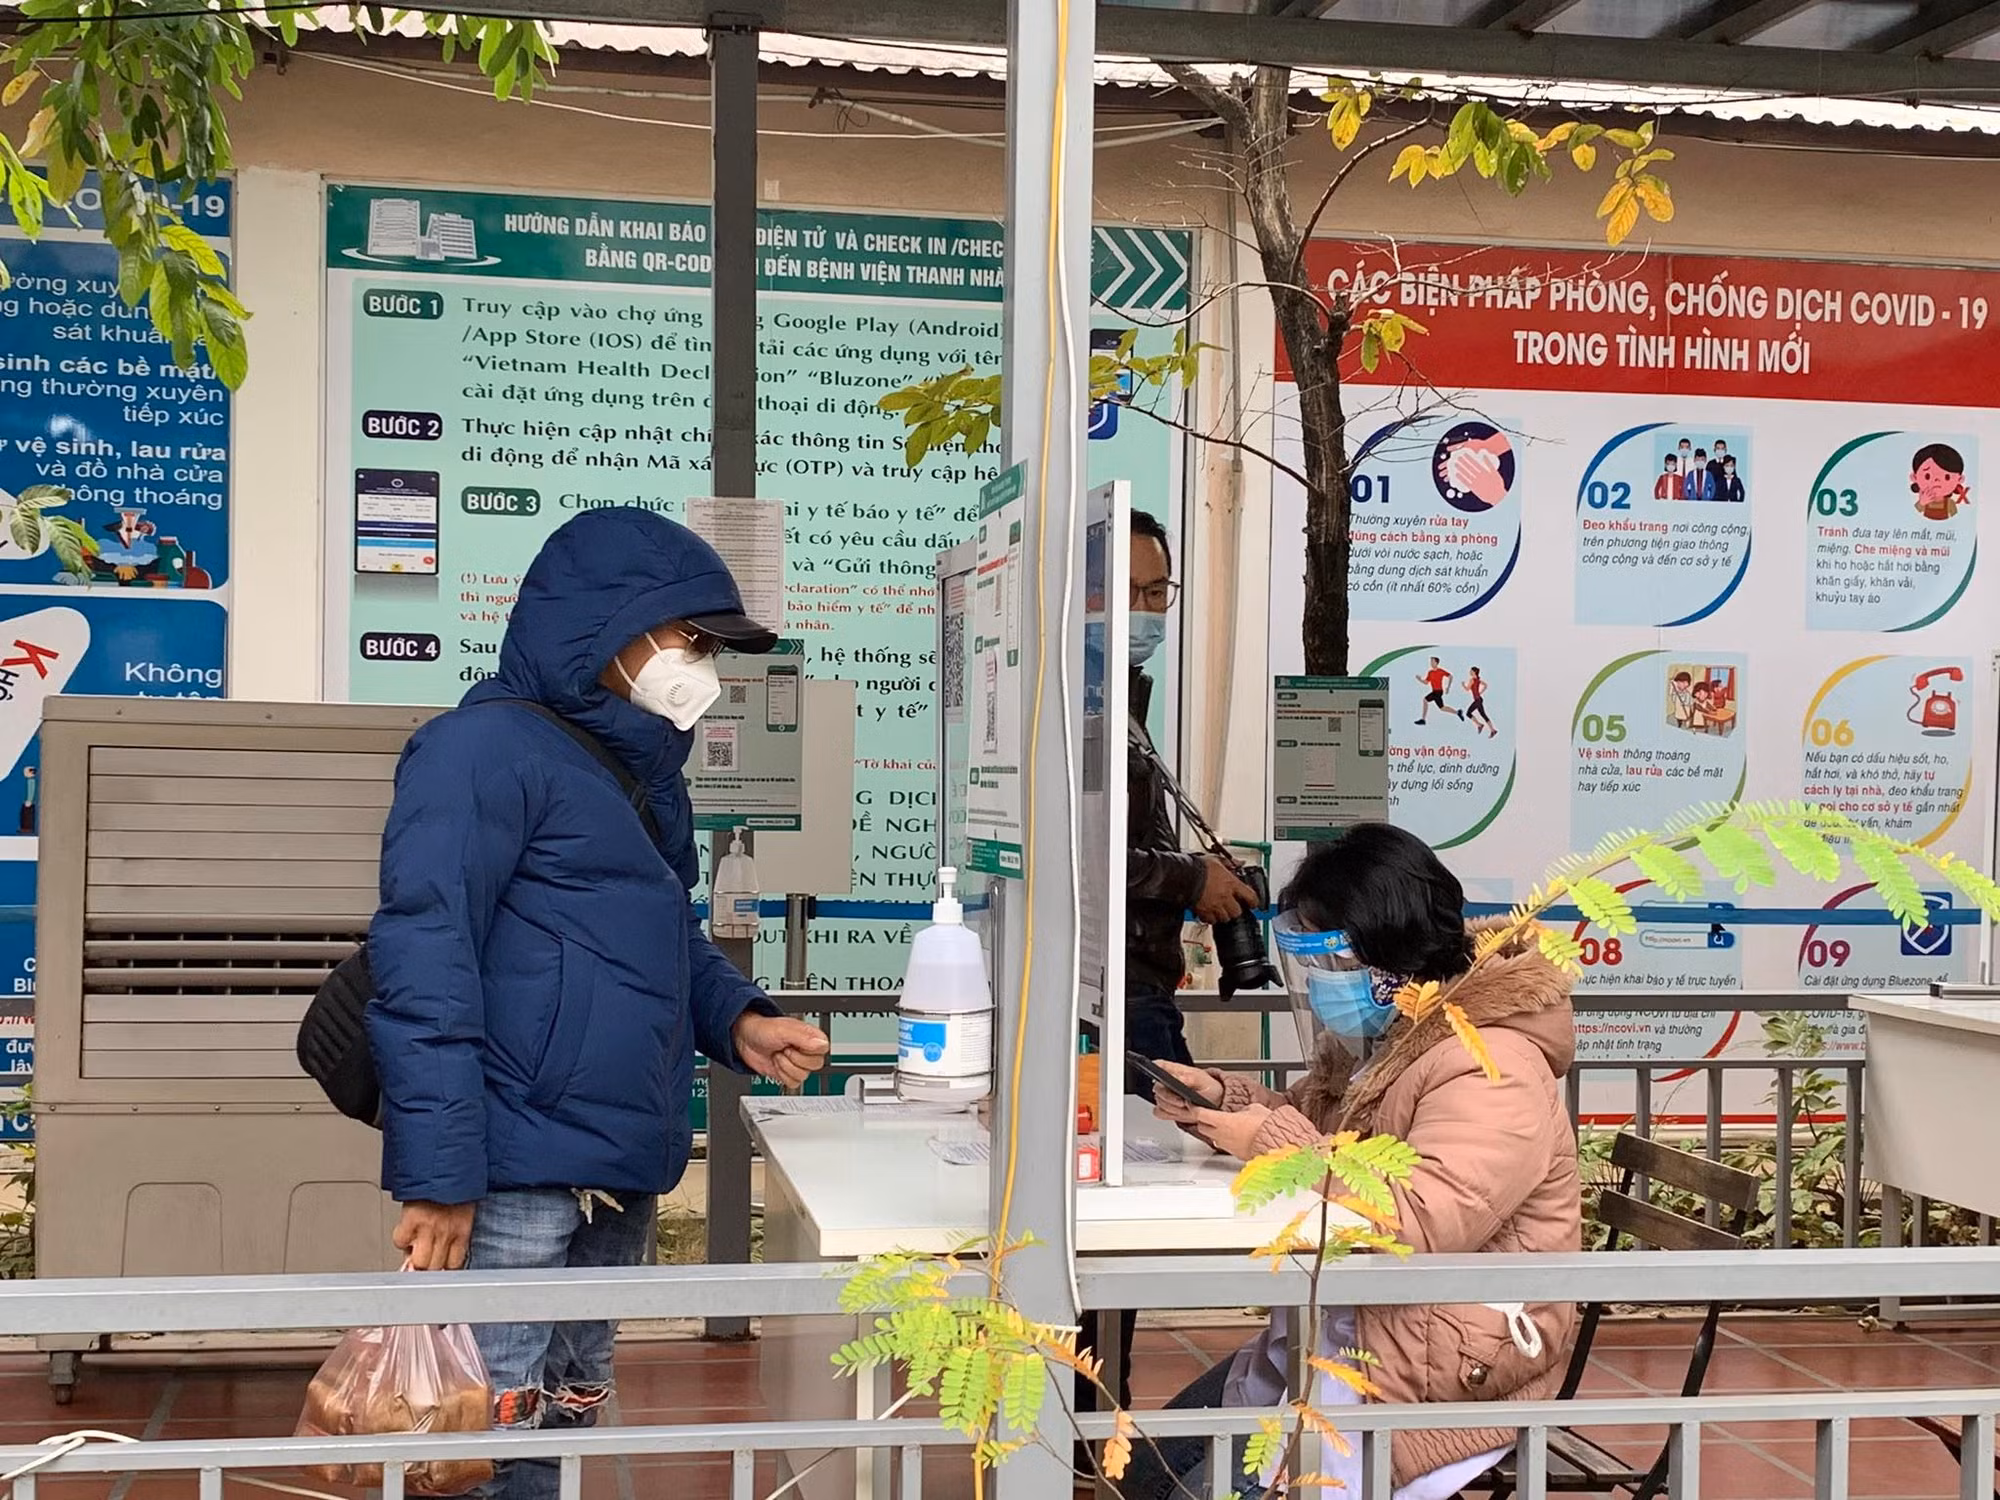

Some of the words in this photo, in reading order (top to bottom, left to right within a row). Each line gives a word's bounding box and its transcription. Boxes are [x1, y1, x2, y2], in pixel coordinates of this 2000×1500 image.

[504, 210, 569, 235] HƯỚNG
[575, 212, 615, 239] DẪN
[619, 220, 664, 241] KHAI
[756, 225, 797, 249] ĐIỆN
[803, 225, 827, 250] TỬ
[834, 227, 858, 251] VÀ
[863, 234, 922, 255] CHECK
[928, 237, 946, 255] IN
[950, 238, 1003, 259] /CHEC
[585, 242, 637, 269] BẰNG
[642, 251, 712, 274] QR-COD
[764, 254, 800, 277] ĐẾN
[807, 255, 855, 284] BỆNH
[860, 261, 901, 286] VIỆN
[906, 264, 965, 286] THANH
[970, 265, 1003, 289] NHÀ
[369, 292, 421, 315] BƯỚC
[430, 299, 439, 316] 1
[1328, 260, 1390, 304] CÁC
[1401, 265, 1457, 316] BIỆN
[1469, 265, 1541, 310] PHÁP
[1550, 270, 1656, 320] PHÒNG,
[1665, 270, 1768, 319] CHỐNG
[1776, 288, 1842, 330] DỊCH
[1850, 291, 1935, 327] COVID
[1959, 297, 1988, 329] 19
[29, 297, 93, 319] hoặc
[101, 302, 149, 320] dun
[462, 298, 511, 318] Truy
[522, 301, 561, 321] cập
[571, 302, 607, 320] vào
[617, 303, 656, 324] chợ
[664, 305, 703, 327] ứng
[774, 312, 847, 335] Google
[855, 316, 899, 338] Play
[53, 323, 92, 341] sát
[462, 325, 517, 346] /App
[525, 328, 581, 347] Store
[589, 331, 642, 351] (IOS)
[651, 331, 677, 352] để
[759, 340, 785, 357] tải
[793, 342, 827, 359] các
[834, 343, 873, 365] ứng
[880, 344, 930, 366] dụng
[937, 346, 967, 366] với
[1513, 330, 1608, 366] TRONG
[1616, 325, 1675, 368] TÌNH
[1684, 326, 1749, 372] HÌNH
[1758, 330, 1810, 374] MỚI
[59, 357, 108, 375] các
[118, 356, 151, 376] bề
[577, 360, 650, 378] Health
[42, 379, 137, 400] thường
[146, 383, 223, 405] xuyên
[462, 383, 494, 400] cài
[502, 384, 537, 403] đặt
[544, 387, 584, 407] ứng
[591, 388, 645, 410] dụng
[651, 390, 699, 408] trên
[758, 395, 808, 415] thoại
[816, 398, 836, 413] di
[124, 402, 170, 426] tiếp
[179, 408, 224, 426] xúc
[368, 414, 420, 436] BƯỚC
[427, 419, 440, 437] 2
[462, 418, 516, 438] Thực
[523, 420, 570, 440] hiện
[579, 424, 617, 443] cập
[624, 425, 672, 444] nhật
[792, 433, 850, 452] thông
[857, 436, 885, 451] tin
[15, 436, 47, 455] vệ
[56, 440, 121, 459] sinh,
[131, 440, 170, 459] lau
[180, 442, 226, 461] rửa
[36, 463, 66, 478] và
[75, 459, 108, 479] đồ
[117, 462, 164, 481] nhà
[174, 465, 223, 483] cửa
[461, 446, 481, 462] di
[490, 448, 544, 468] động
[551, 447, 579, 465] để
[585, 452, 639, 470] nhận
[646, 455, 680, 471] Mã
[786, 458, 843, 477] (OTP)
[851, 462, 874, 477] và
[883, 465, 923, 483] truy
[931, 466, 966, 485] cập
[135, 485, 223, 511] thoáng
[1351, 474, 1390, 503] 01
[1587, 481, 1631, 510] 02
[466, 492, 519, 512] BƯỚC
[525, 495, 537, 512] 3
[807, 505, 818, 521] y
[826, 500, 848, 517] tế
[853, 503, 890, 520] báo
[897, 509, 908, 524] y
[953, 503, 978, 522] để
[1816, 488, 1859, 517] 03
[809, 530, 832, 545] có
[840, 531, 875, 549] yêu
[882, 529, 917, 548] cầu
[792, 557, 815, 572] và
[880, 559, 936, 580] thông
[366, 636, 418, 657] BƯỚC
[424, 640, 438, 657] 4
[460, 638, 497, 654] Sau
[821, 646, 846, 666] hệ
[854, 645, 911, 668] thống
[126, 662, 222, 688] Không
[866, 675, 920, 695] người
[875, 705, 886, 722] y
[1582, 713, 1627, 743] 05
[1811, 718, 1854, 747] 06
[848, 929, 876, 944] RA
[884, 922, 912, 944] VỀ
[1579, 937, 1623, 966] 08
[1807, 939, 1851, 968] 09
